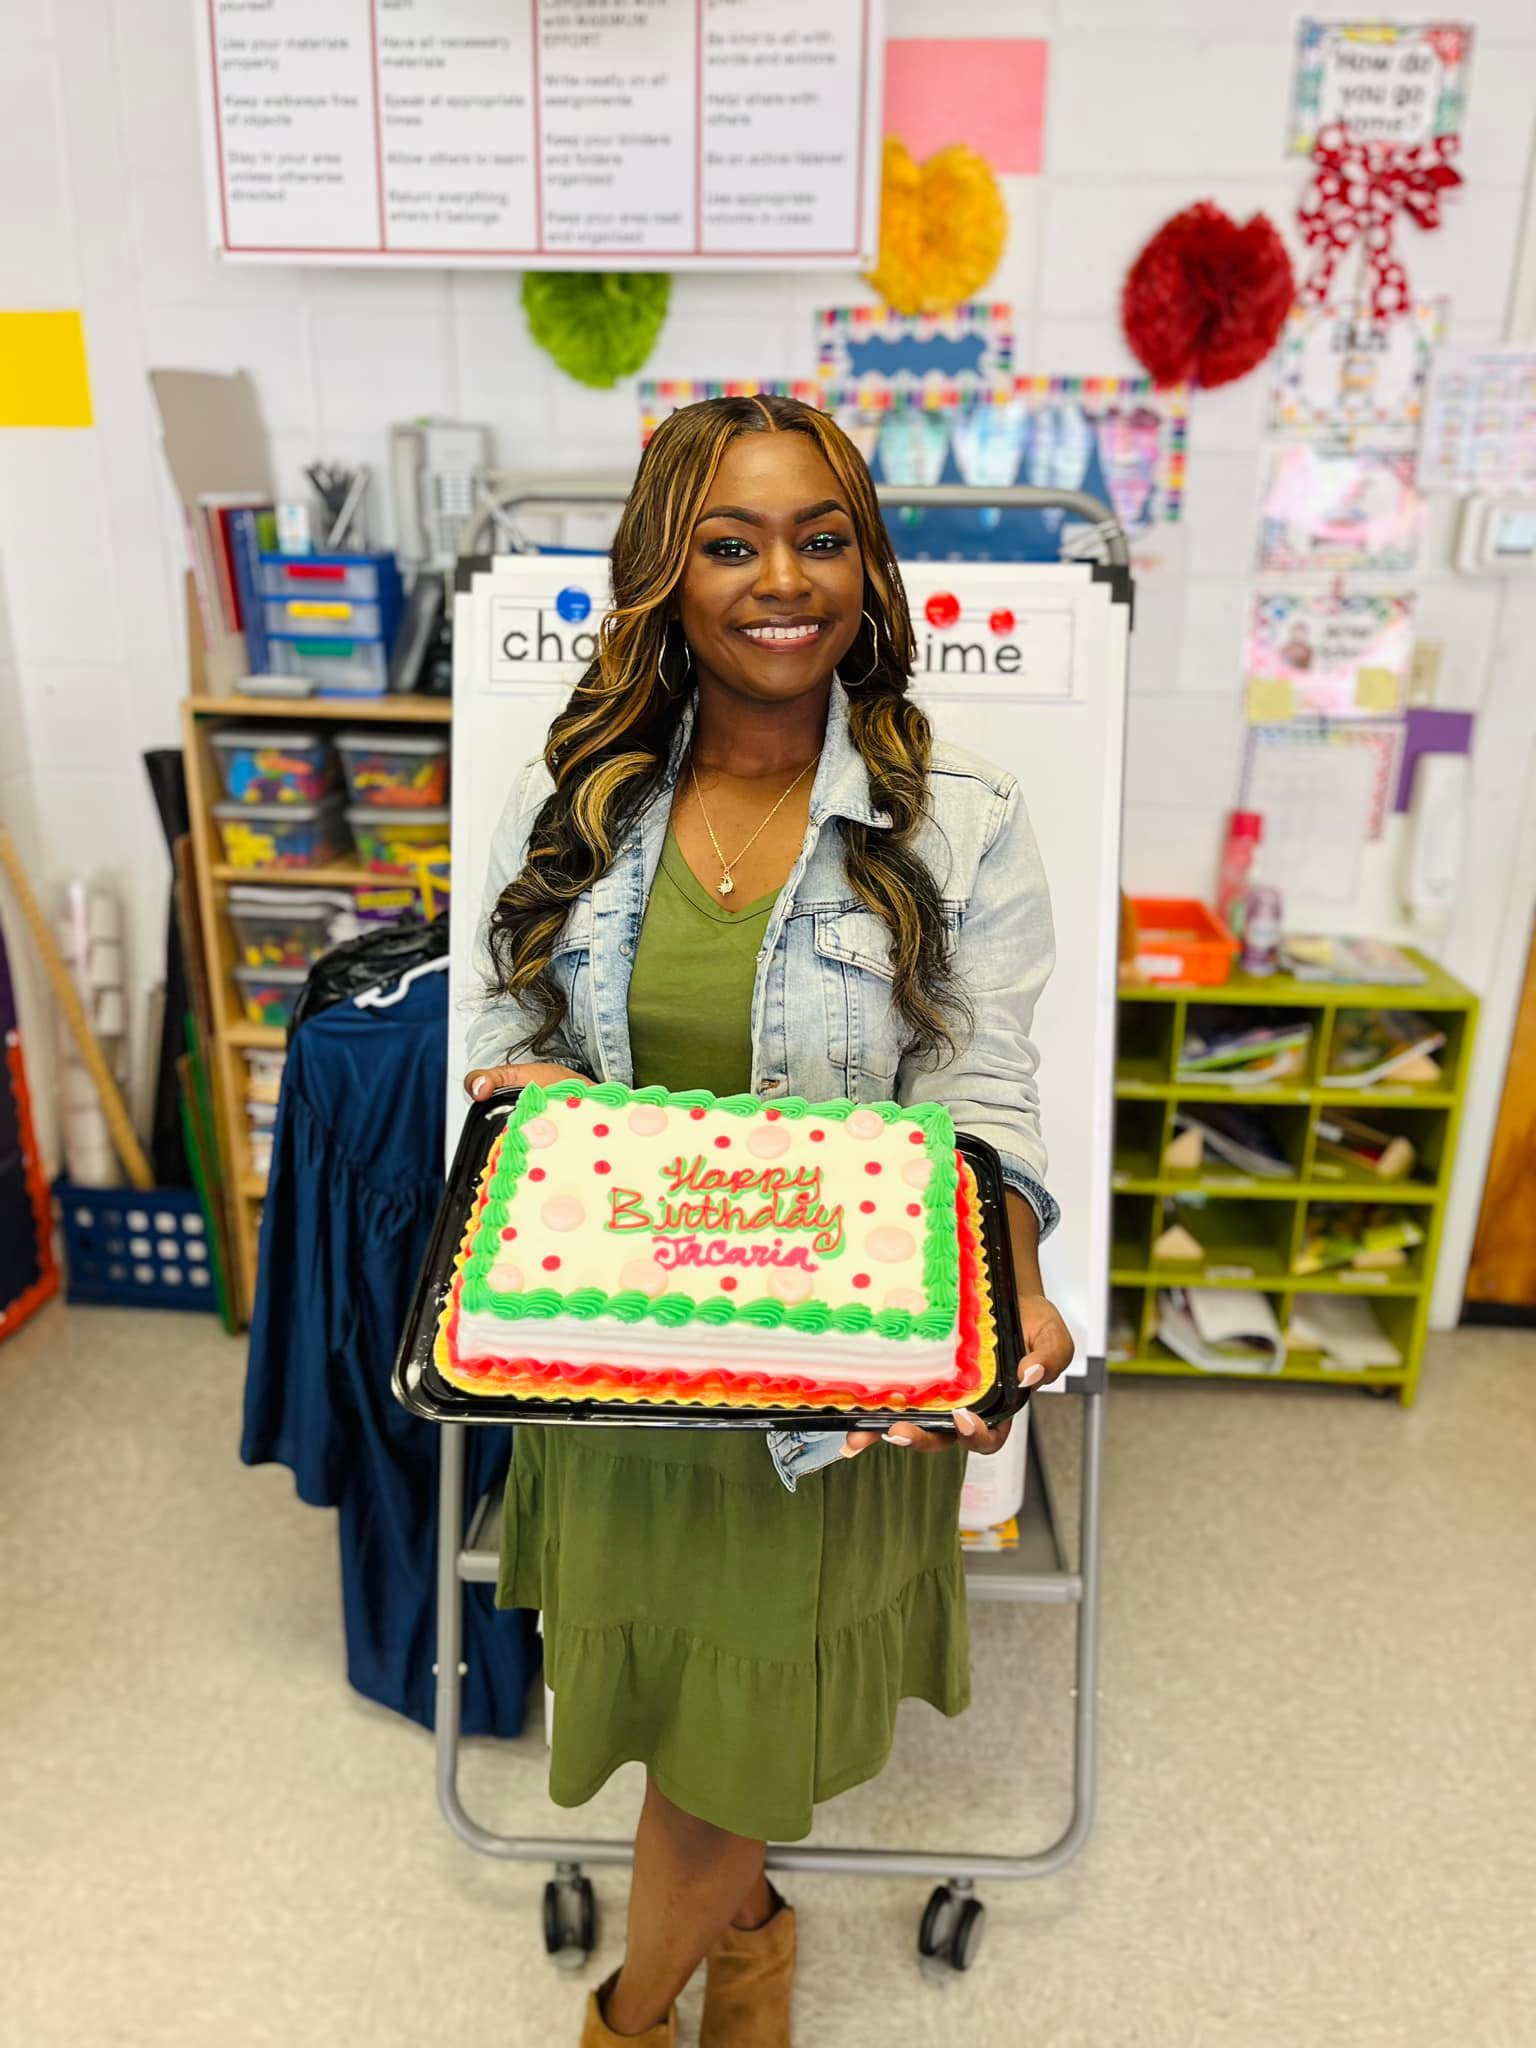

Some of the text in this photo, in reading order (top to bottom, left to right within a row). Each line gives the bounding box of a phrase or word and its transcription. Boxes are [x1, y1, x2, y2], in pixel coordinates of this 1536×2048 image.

[1336, 51, 1432, 73] How do
[1339, 84, 1385, 106] you
[503, 608, 1022, 674] cha ime
[660, 1154, 824, 1208] Happy
[603, 1186, 847, 1260] Birthday
